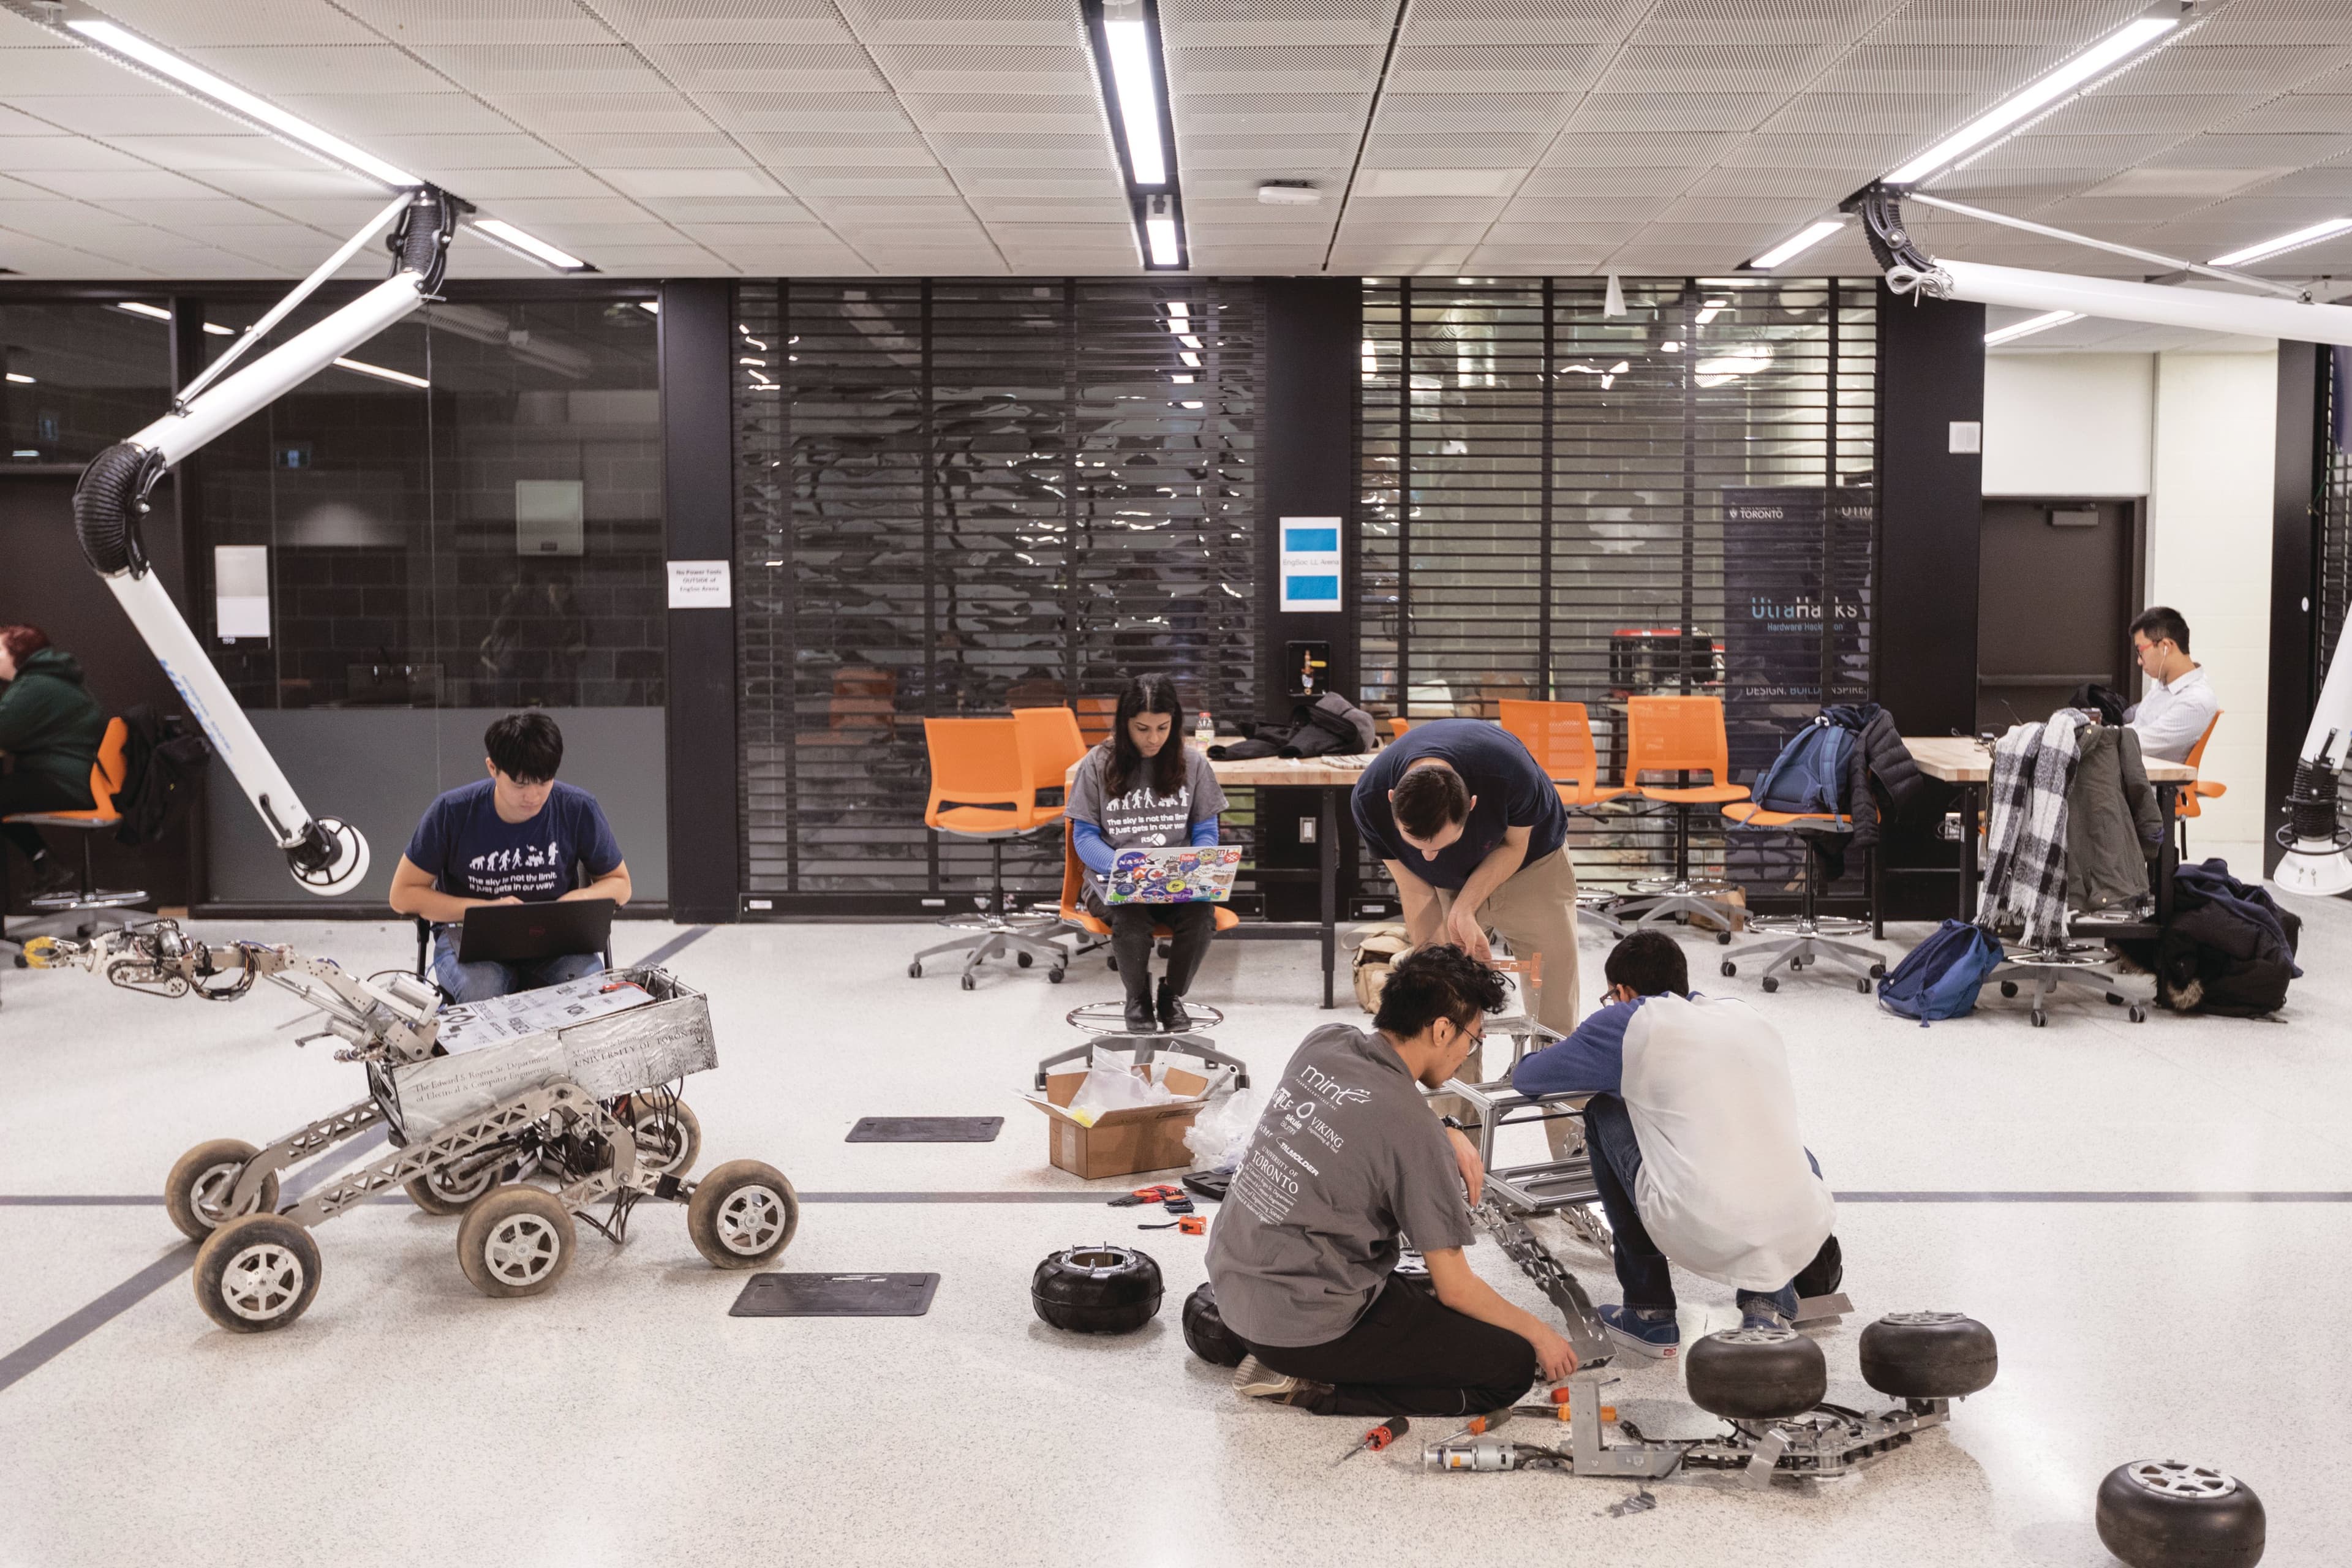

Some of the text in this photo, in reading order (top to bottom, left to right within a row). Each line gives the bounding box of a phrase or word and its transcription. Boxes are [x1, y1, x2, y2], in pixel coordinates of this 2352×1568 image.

[1740, 509, 1784, 519] TORONTO
[1768, 622, 1803, 631] Hardware
[1832, 687, 1867, 695] NSPIRE.
[1132, 825, 1148, 834] gets
[468, 875, 484, 885] The
[485, 878, 501, 887] sky
[477, 884, 492, 894] just
[494, 884, 512, 894] gets
[1301, 1065, 1350, 1105] mint
[1285, 1114, 1302, 1129] skule
[1311, 1116, 1344, 1148] VIKING
[1262, 1145, 1298, 1177] UNIVERSITY OF
[1252, 1150, 1298, 1194] TORONTO
[1273, 1189, 1294, 1207] Department
